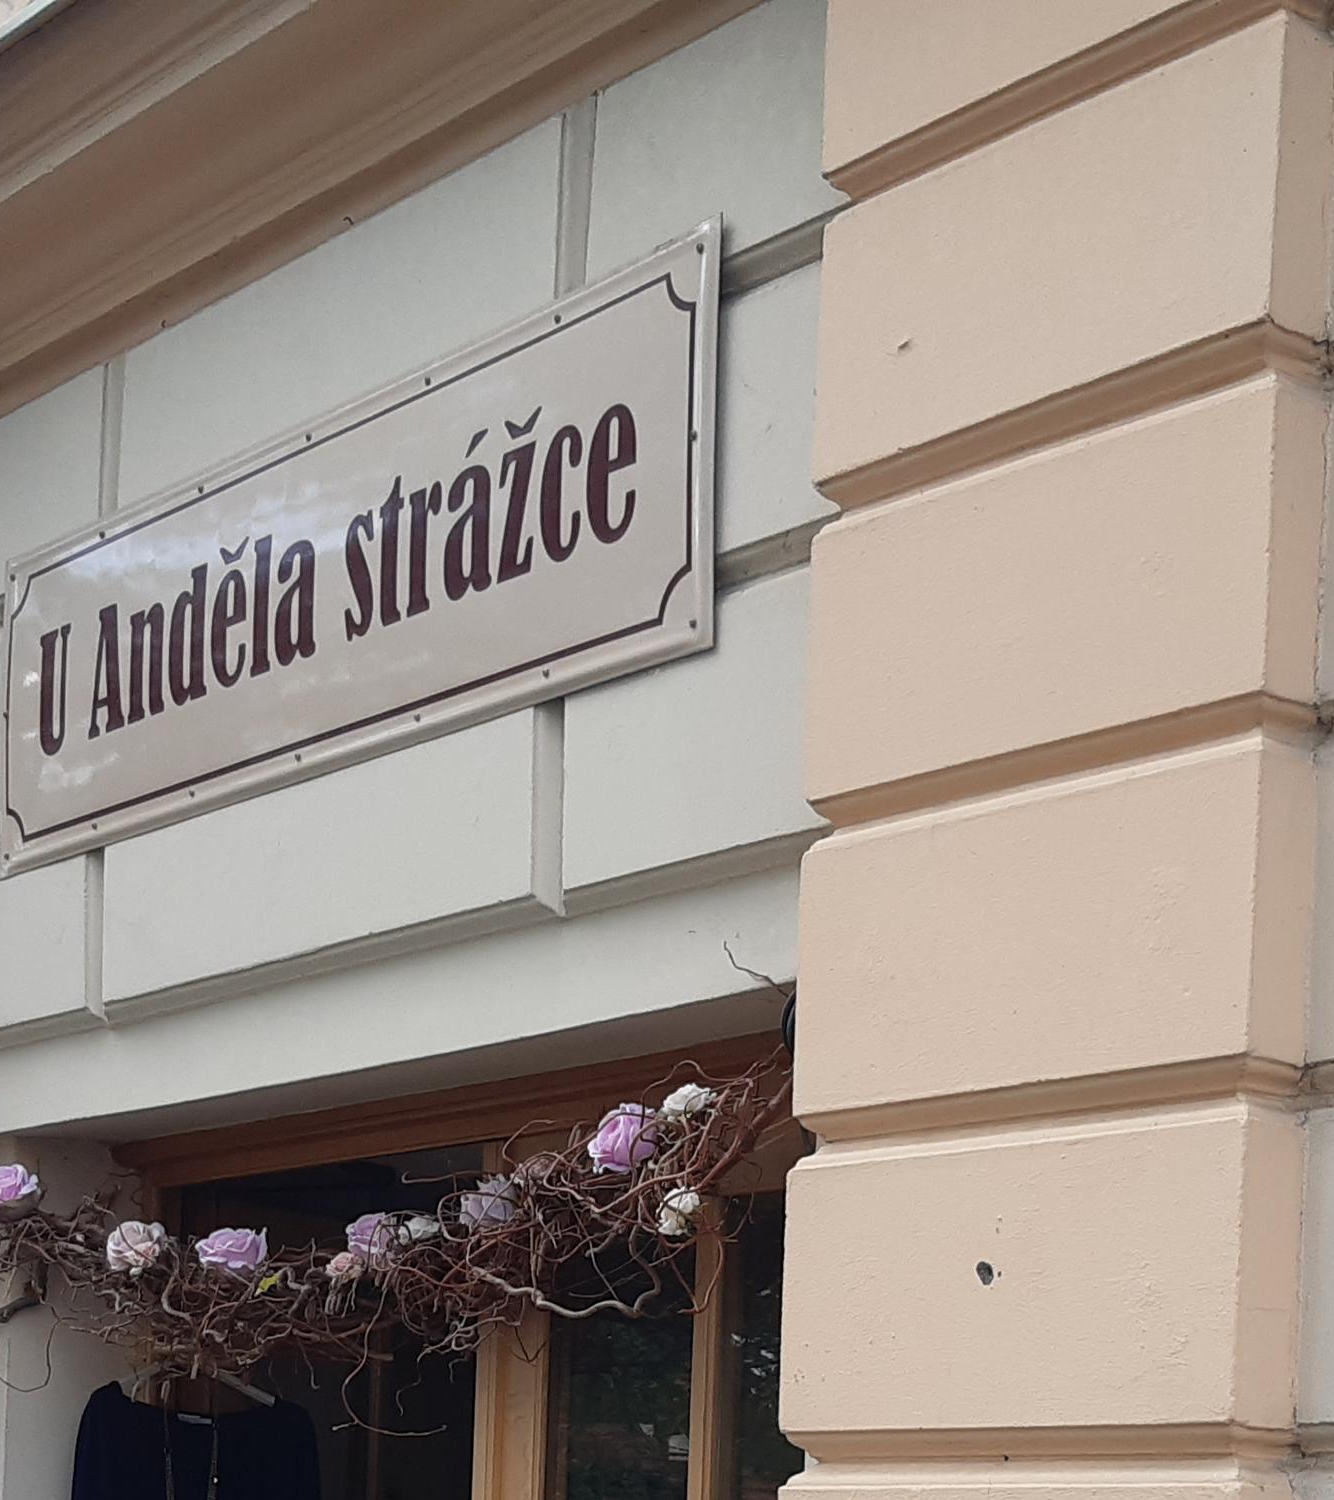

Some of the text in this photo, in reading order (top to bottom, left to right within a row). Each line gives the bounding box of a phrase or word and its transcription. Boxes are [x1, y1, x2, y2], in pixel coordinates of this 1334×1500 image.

[38, 402, 638, 756] U Anděla strážce
